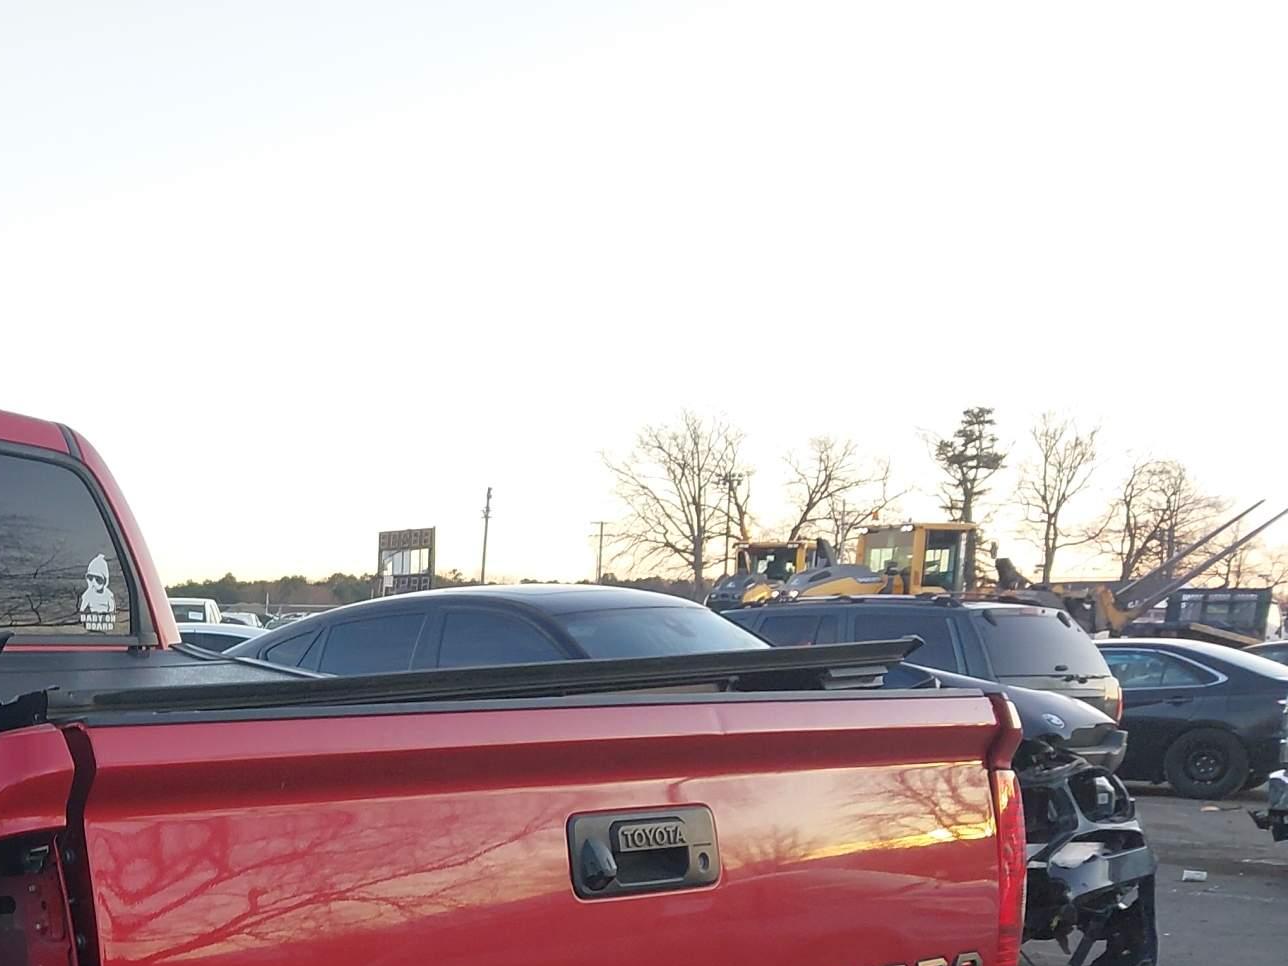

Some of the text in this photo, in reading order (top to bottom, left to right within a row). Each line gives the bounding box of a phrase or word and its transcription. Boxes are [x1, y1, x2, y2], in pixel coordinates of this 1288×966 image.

[80, 614, 116, 622] BABY ON
[86, 622, 114, 631] BOARD
[622, 825, 685, 848] TOYOTA
